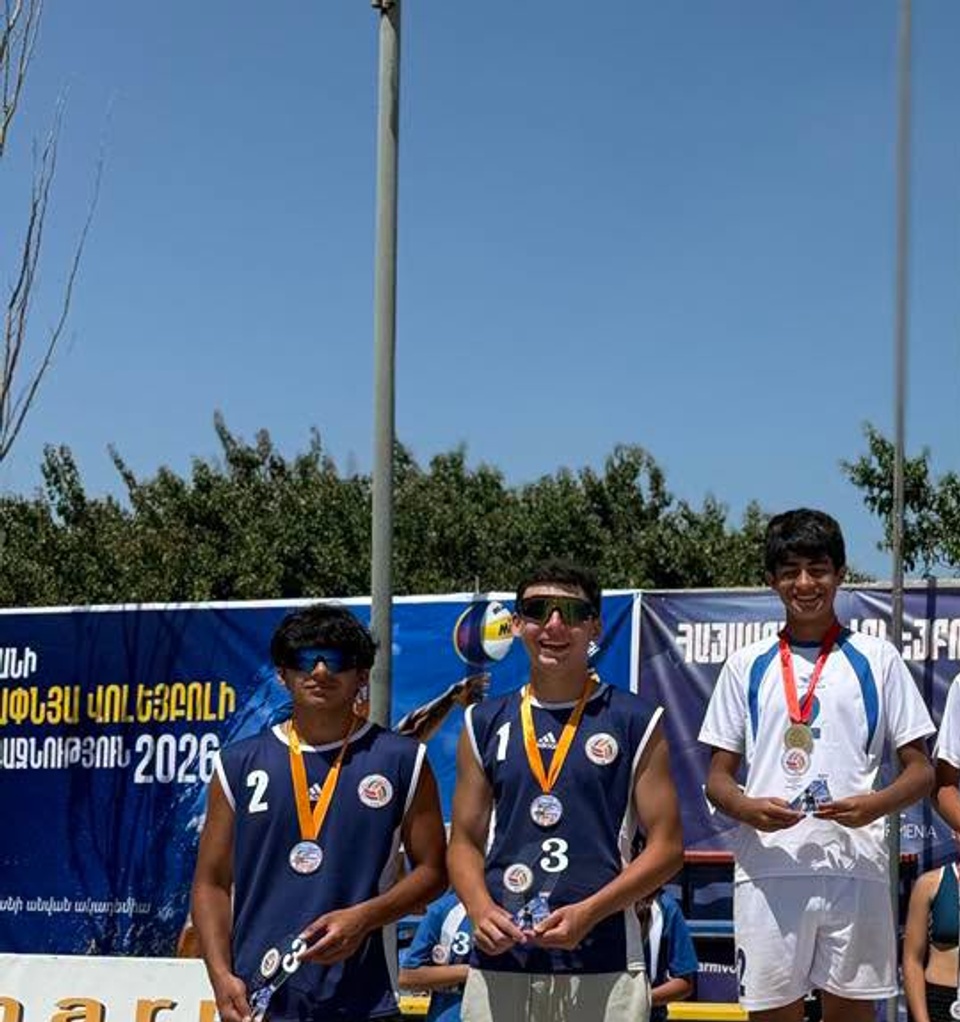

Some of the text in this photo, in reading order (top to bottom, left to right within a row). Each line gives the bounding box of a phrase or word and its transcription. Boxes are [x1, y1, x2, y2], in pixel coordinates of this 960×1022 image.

[134, 733, 220, 784] 2026
[496, 722, 510, 761] 1
[247, 769, 270, 813] 2
[540, 837, 569, 873] 3
[452, 931, 471, 955] 3
